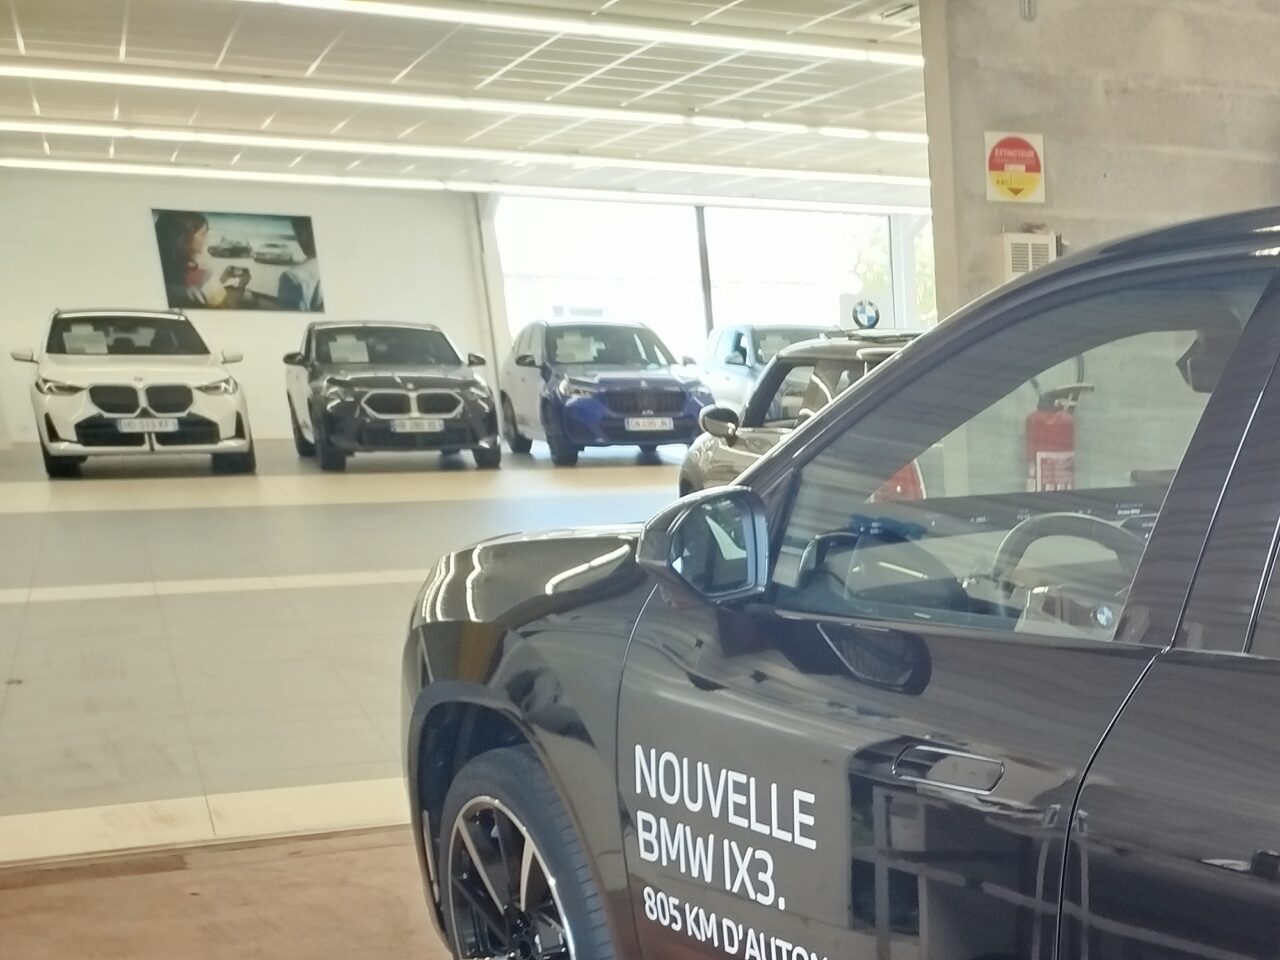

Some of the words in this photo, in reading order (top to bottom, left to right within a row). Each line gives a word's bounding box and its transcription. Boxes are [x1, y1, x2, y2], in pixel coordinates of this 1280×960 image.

[634, 744, 816, 850] NOUVELLE
[636, 810, 714, 883] BMW
[723, 838, 786, 911] IX3.
[643, 886, 682, 932] 805
[684, 902, 719, 948] KM
